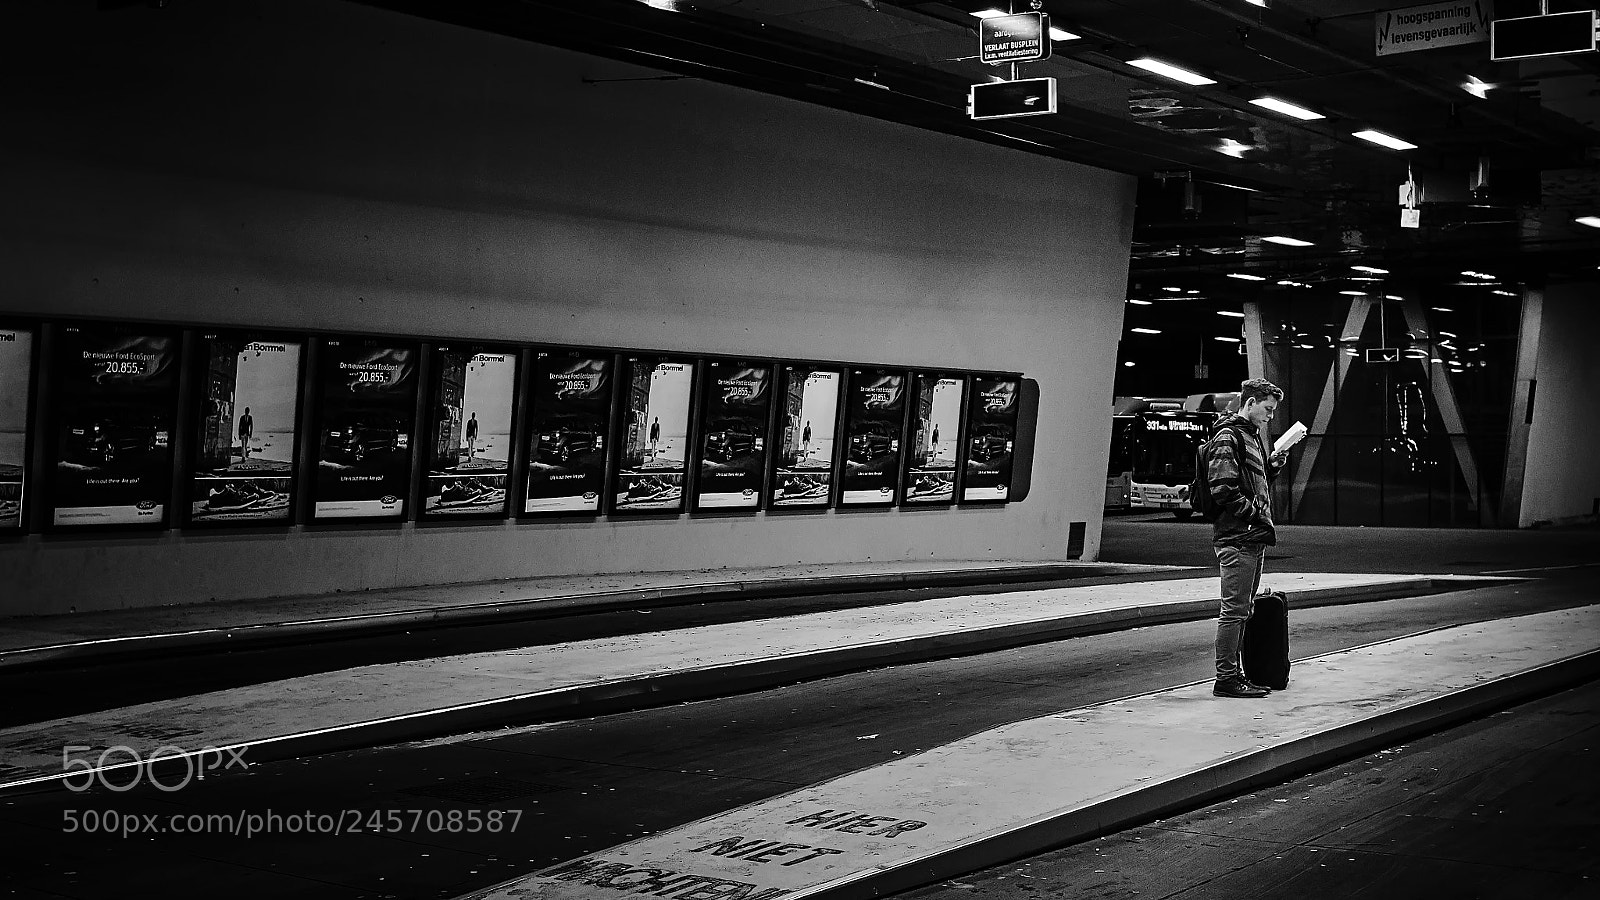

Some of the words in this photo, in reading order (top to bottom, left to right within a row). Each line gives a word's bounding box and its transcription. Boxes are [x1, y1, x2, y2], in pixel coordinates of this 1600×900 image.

[1397, 6, 1471, 25] hoogspanning
[1391, 22, 1477, 44] levensgevaarlijk
[984, 43, 1010, 52] VERLAAT
[1010, 40, 1039, 49] BUSPLEIN
[253, 343, 286, 352] Bommel
[83, 350, 92, 359] De
[115, 352, 129, 360] Ford
[129, 353, 156, 362] EcoSport
[479, 354, 505, 362] Bommel
[785, 809, 928, 838] HIER
[687, 835, 845, 866] NIET
